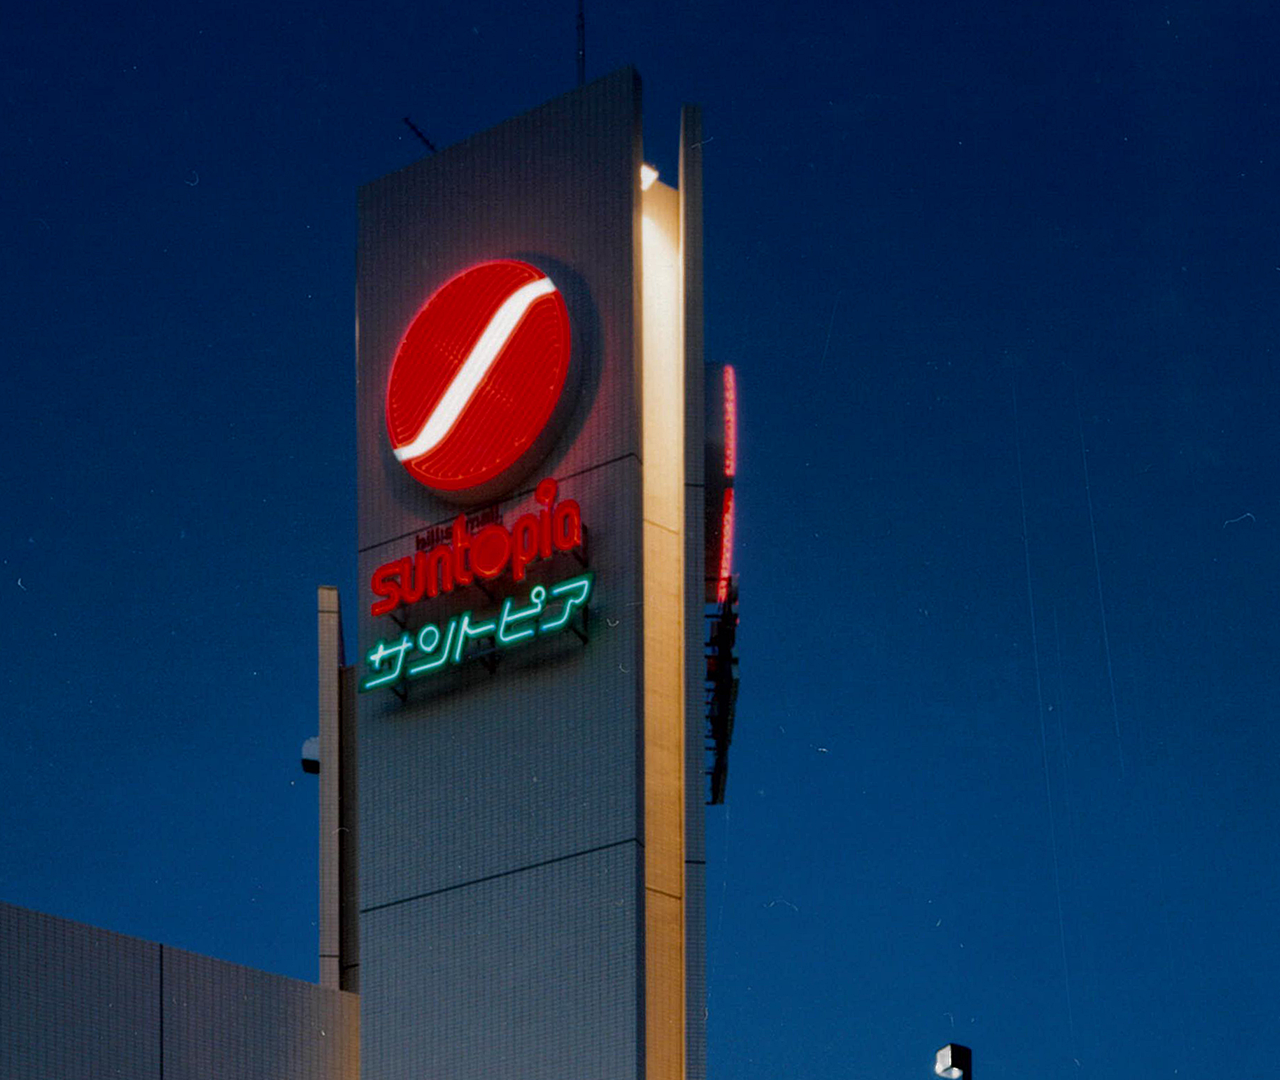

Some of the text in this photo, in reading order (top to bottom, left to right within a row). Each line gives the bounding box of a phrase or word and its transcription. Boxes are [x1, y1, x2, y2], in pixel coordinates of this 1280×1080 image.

[371, 478, 581, 616] suntopia
[363, 577, 591, 689] サントピア
